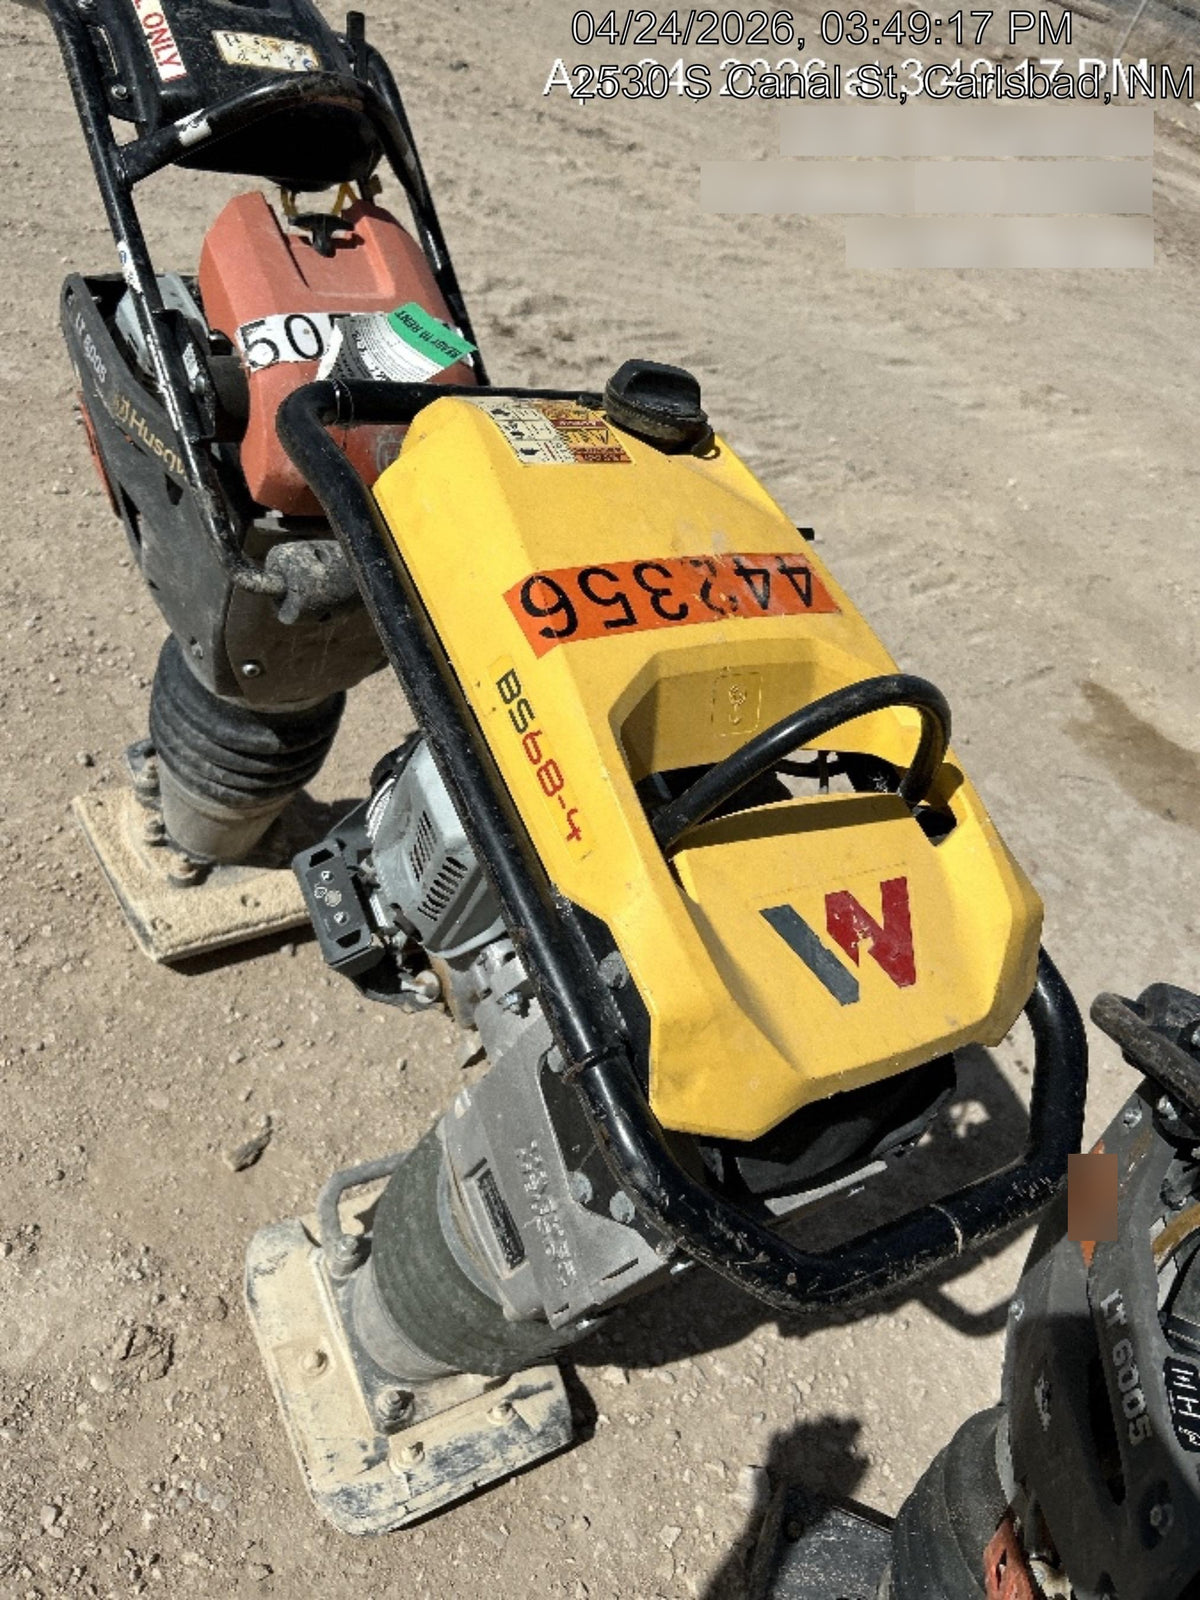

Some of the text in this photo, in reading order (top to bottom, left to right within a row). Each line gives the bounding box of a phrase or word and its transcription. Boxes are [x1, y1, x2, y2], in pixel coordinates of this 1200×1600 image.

[142, 12, 182, 67] ONLY
[241, 313, 351, 367] 50
[520, 556, 815, 639] 442356
[496, 668, 582, 842] BS68-4
[1112, 1338, 1152, 1447] 6005
